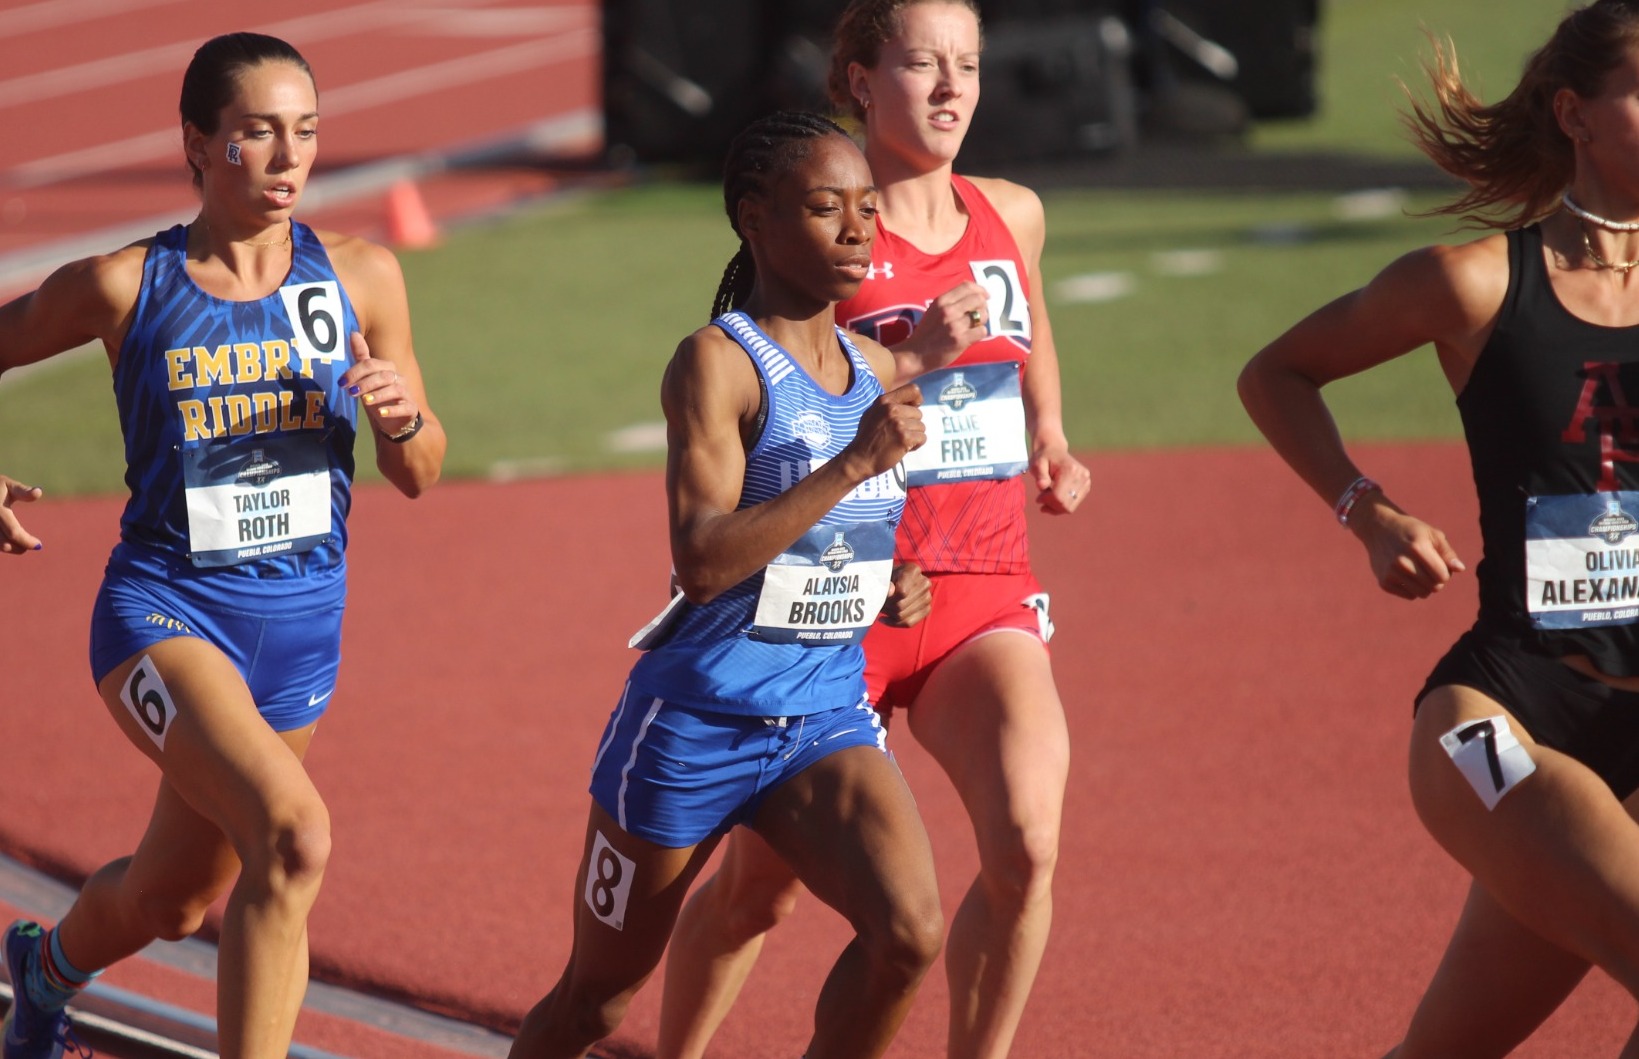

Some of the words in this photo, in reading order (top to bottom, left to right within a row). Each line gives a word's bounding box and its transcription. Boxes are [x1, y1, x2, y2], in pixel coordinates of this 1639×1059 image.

[982, 265, 1023, 331] 2
[297, 286, 338, 354] 6
[178, 390, 326, 442] RIDDLE
[941, 414, 981, 434] ELLIE
[940, 436, 988, 463] FRYE
[233, 489, 290, 513] TAYLOR
[238, 512, 289, 542] ROTH
[1590, 524, 1637, 533] CHAMPIONSHIPS
[237, 546, 261, 558] PUEBLO,
[262, 541, 293, 554] COLORADO
[802, 574, 859, 596] ALAYSIA
[1541, 576, 1639, 606] ALEXAN
[787, 597, 866, 625] BROOKS
[1582, 611, 1612, 621] PUEBLO,
[796, 631, 822, 640] PUEBLO,
[822, 630, 854, 640] COLORADO
[129, 668, 167, 737] 6
[1456, 718, 1506, 794] 7
[591, 846, 623, 918] 8
